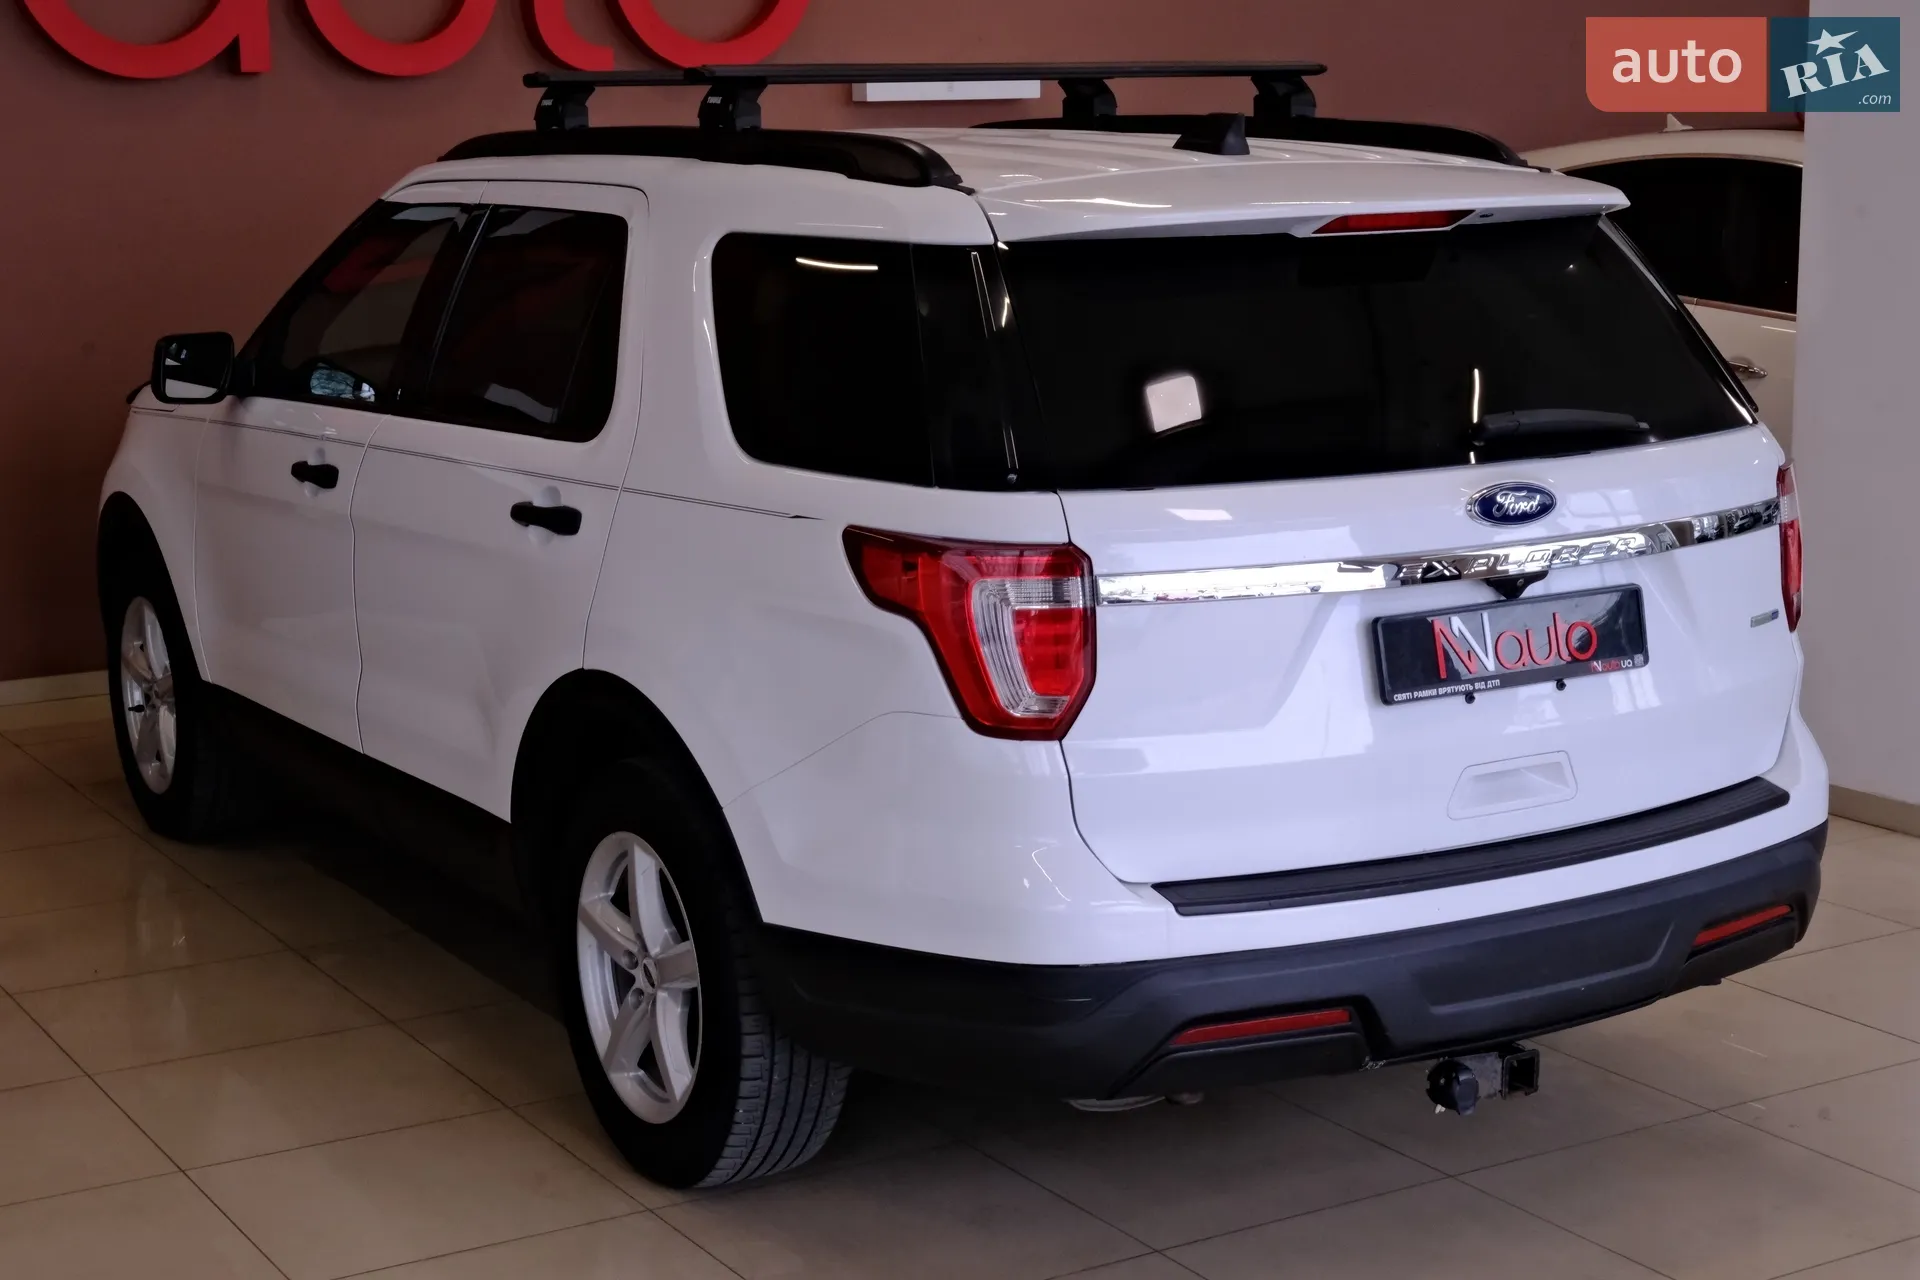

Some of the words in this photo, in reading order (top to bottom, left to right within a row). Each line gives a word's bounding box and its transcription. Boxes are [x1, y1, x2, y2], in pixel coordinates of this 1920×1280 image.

[1492, 490, 1541, 517] Ford
[1398, 537, 1646, 578] EXPLORER
[1393, 691, 1413, 702] СВЯТІ
[1413, 688, 1437, 699] РАМКИ
[1438, 683, 1474, 695] ВРЯТУЮТЬ
[1474, 681, 1486, 690] ВІД
[1487, 679, 1501, 688] ДТП
